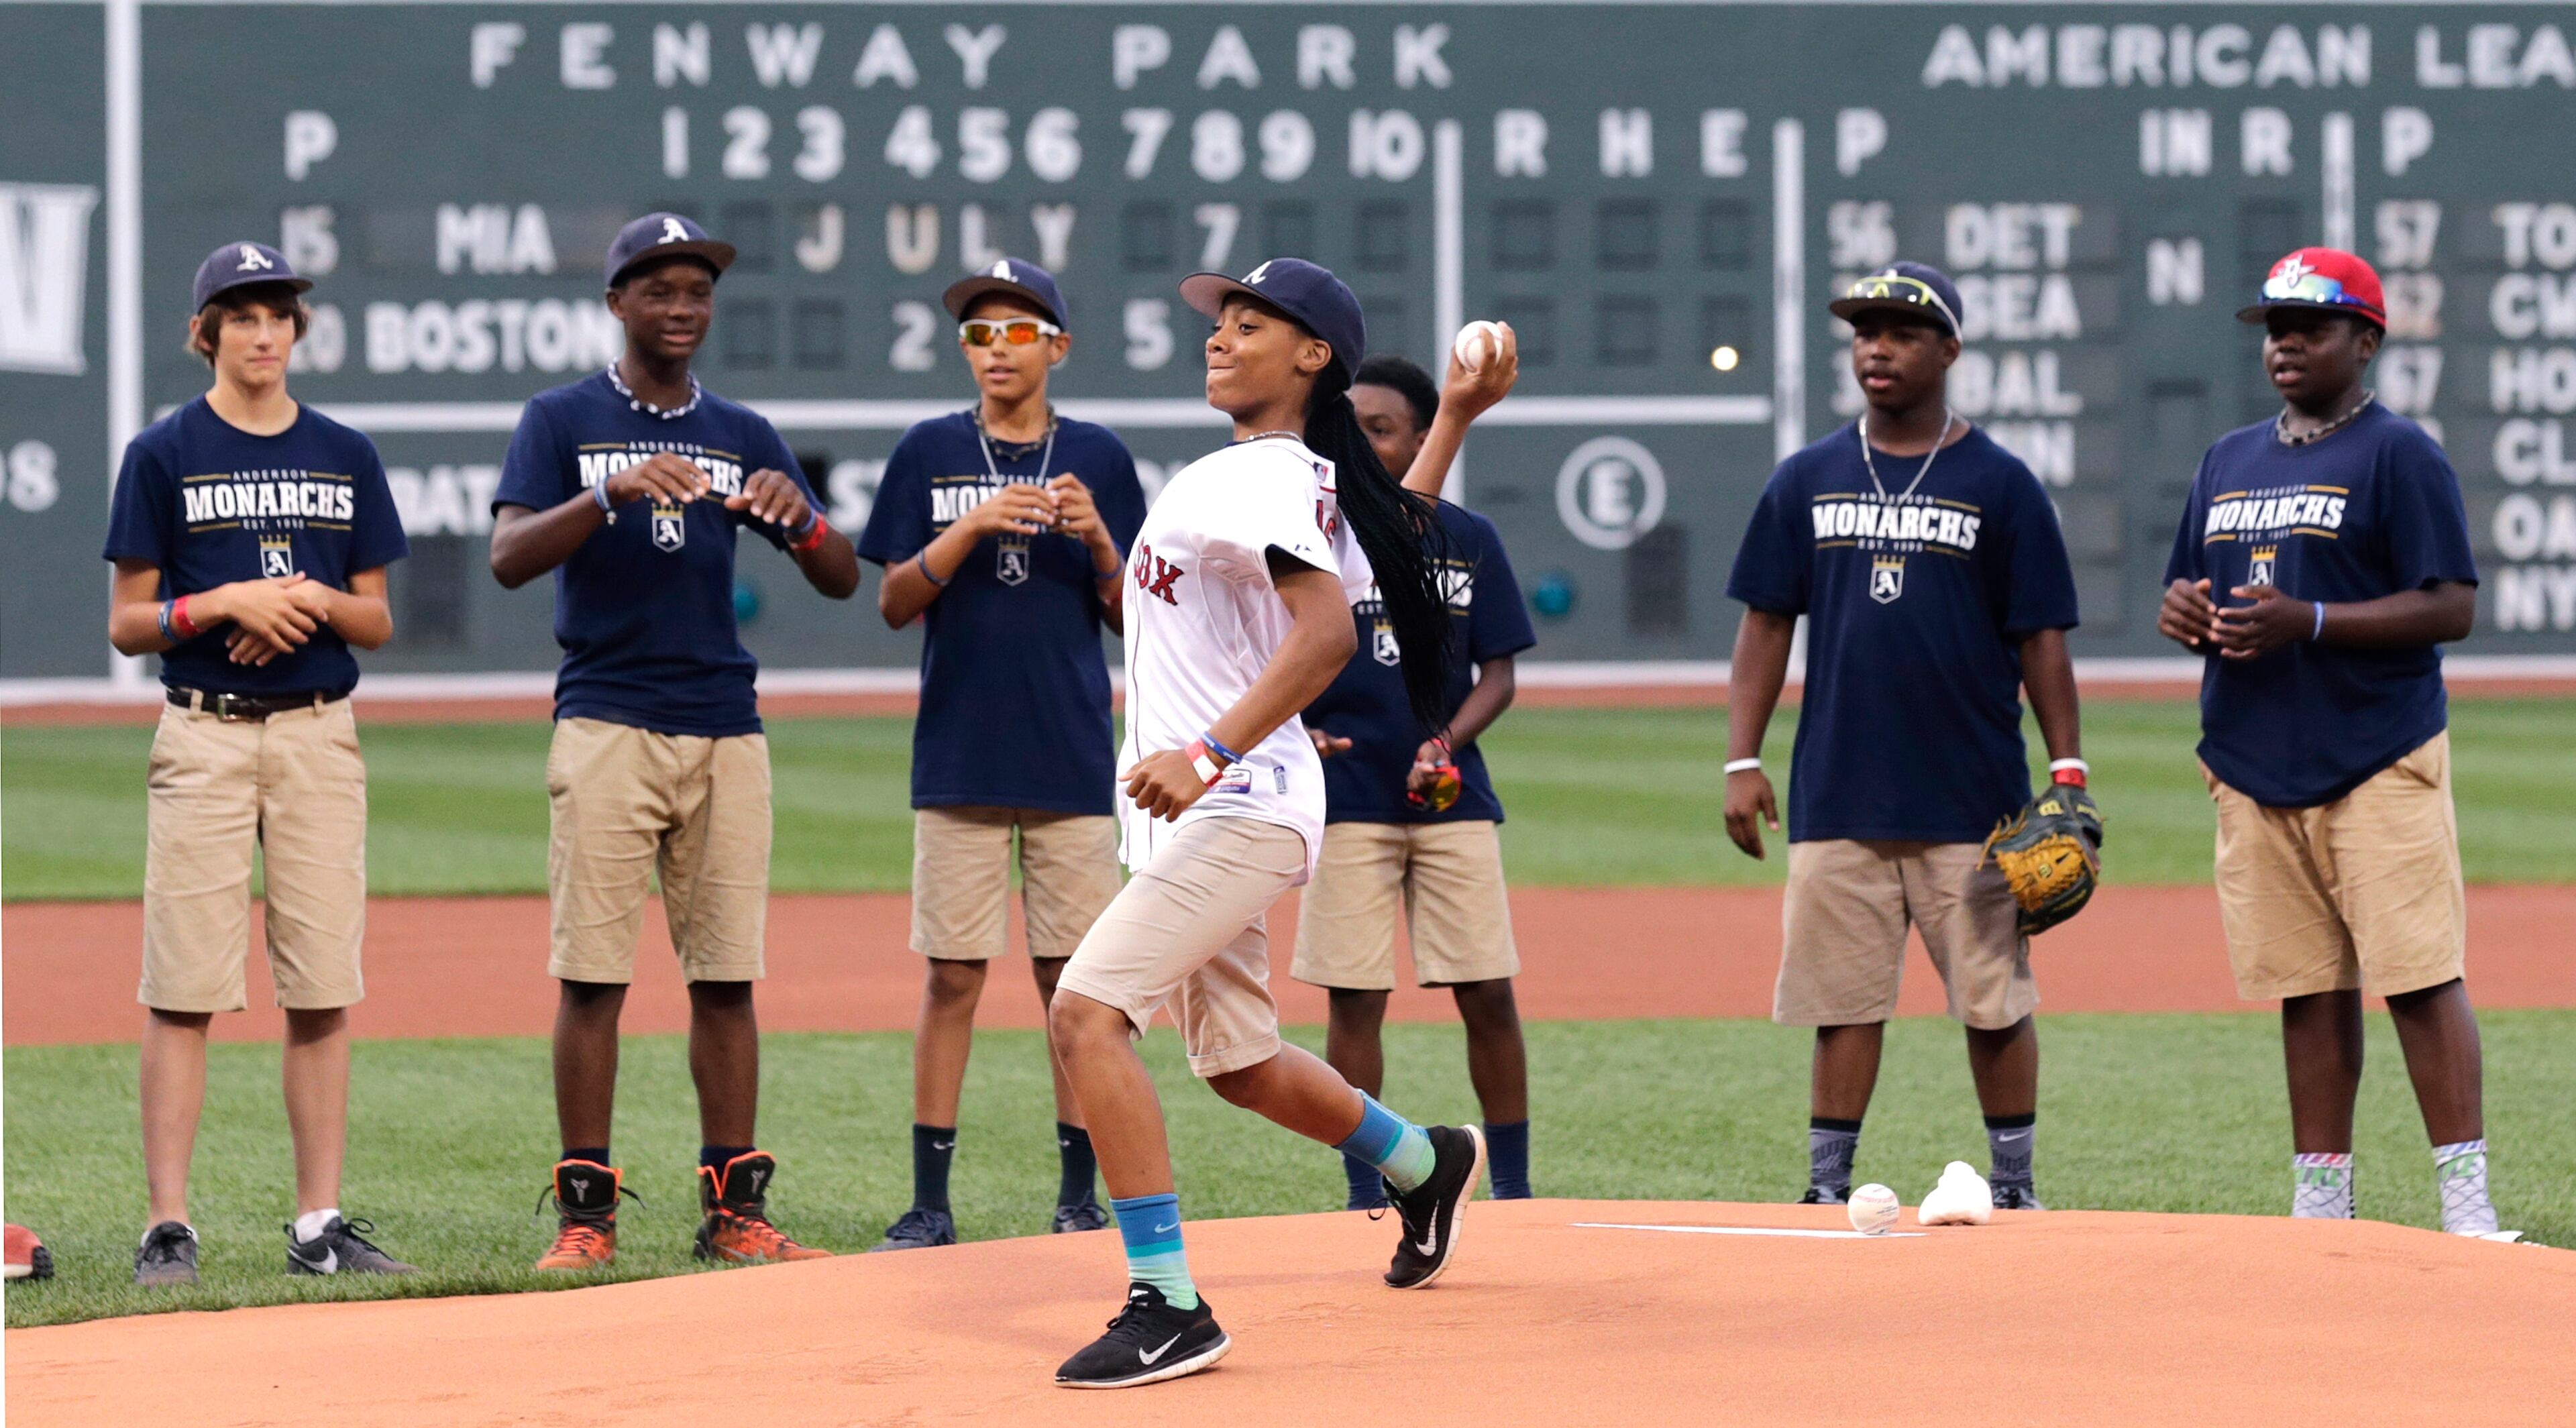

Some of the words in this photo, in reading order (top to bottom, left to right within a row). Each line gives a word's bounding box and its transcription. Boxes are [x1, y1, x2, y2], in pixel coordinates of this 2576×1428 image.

[470, 21, 1004, 89] FENWAY
[1112, 23, 1452, 89] PARK
[1922, 23, 2373, 87] AMERICAN
[2416, 23, 2576, 87] LEA
[284, 111, 337, 179] P
[662, 107, 689, 178] 1
[722, 107, 771, 179] 2
[794, 106, 845, 181] 3
[885, 106, 940, 177] 4
[959, 107, 1011, 182] 5
[1024, 107, 1081, 182] 6
[1122, 108, 1172, 179] 7
[1191, 110, 1245, 182] 8
[1258, 110, 1316, 181] 9
[1348, 109, 1426, 181] 10
[1493, 109, 1548, 177] R
[1599, 109, 1653, 177] H
[1700, 109, 1747, 177] E
[1836, 108, 1887, 176] P
[2139, 109, 2212, 176] IN
[2240, 107, 2293, 175] R
[2381, 107, 2433, 176] P
[279, 206, 339, 275] 15
[436, 204, 557, 274] MIA
[1945, 203, 2080, 268] DET
[2375, 200, 2441, 268] 57
[2491, 202, 2576, 269] TO
[2147, 238, 2205, 305] N
[365, 299, 625, 373] BOSTON
[889, 300, 936, 372] 2
[1122, 299, 1174, 371] 5
[2489, 347, 2576, 413] HO
[182, 482, 354, 523] MONARCHS
[233, 469, 309, 482] ANDERSON
[1589, 460, 1634, 524] E
[1811, 502, 1982, 551] MONARCHS
[2204, 494, 2347, 530] MONARCHS
